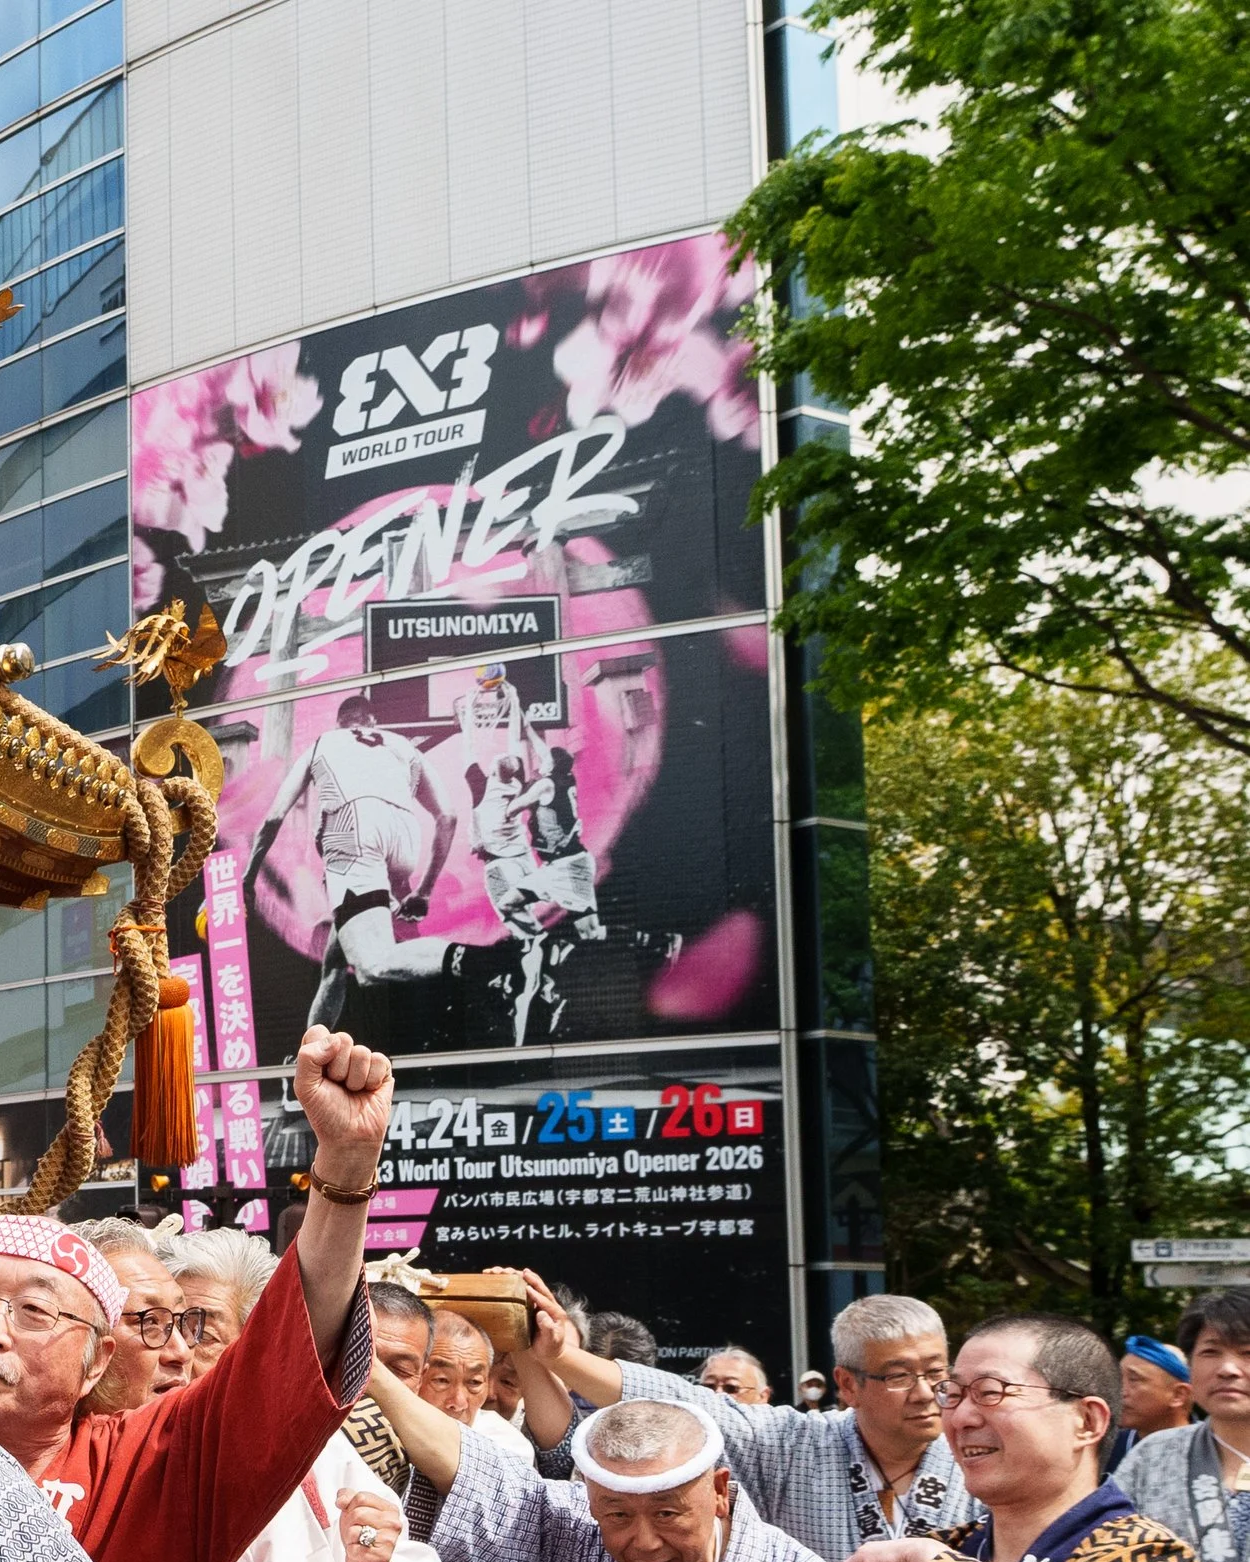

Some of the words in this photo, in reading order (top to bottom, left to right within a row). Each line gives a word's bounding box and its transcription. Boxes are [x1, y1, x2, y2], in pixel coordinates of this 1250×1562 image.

[342, 436, 407, 466] WORLD
[413, 423, 464, 448] TOUR
[223, 414, 640, 667] OPENER
[388, 612, 539, 640] UTSUNOMIYA
[490, 1119, 509, 1138] 金
[537, 1091, 595, 1144] 25
[607, 1112, 630, 1134] 土
[660, 1083, 724, 1138] 26
[734, 1106, 755, 1129] 日
[397, 1157, 450, 1182] World
[453, 1156, 496, 1180] Tour
[500, 1151, 619, 1179] Utsunomiya
[623, 1149, 700, 1178] Opener
[705, 1145, 764, 1171] 2026
